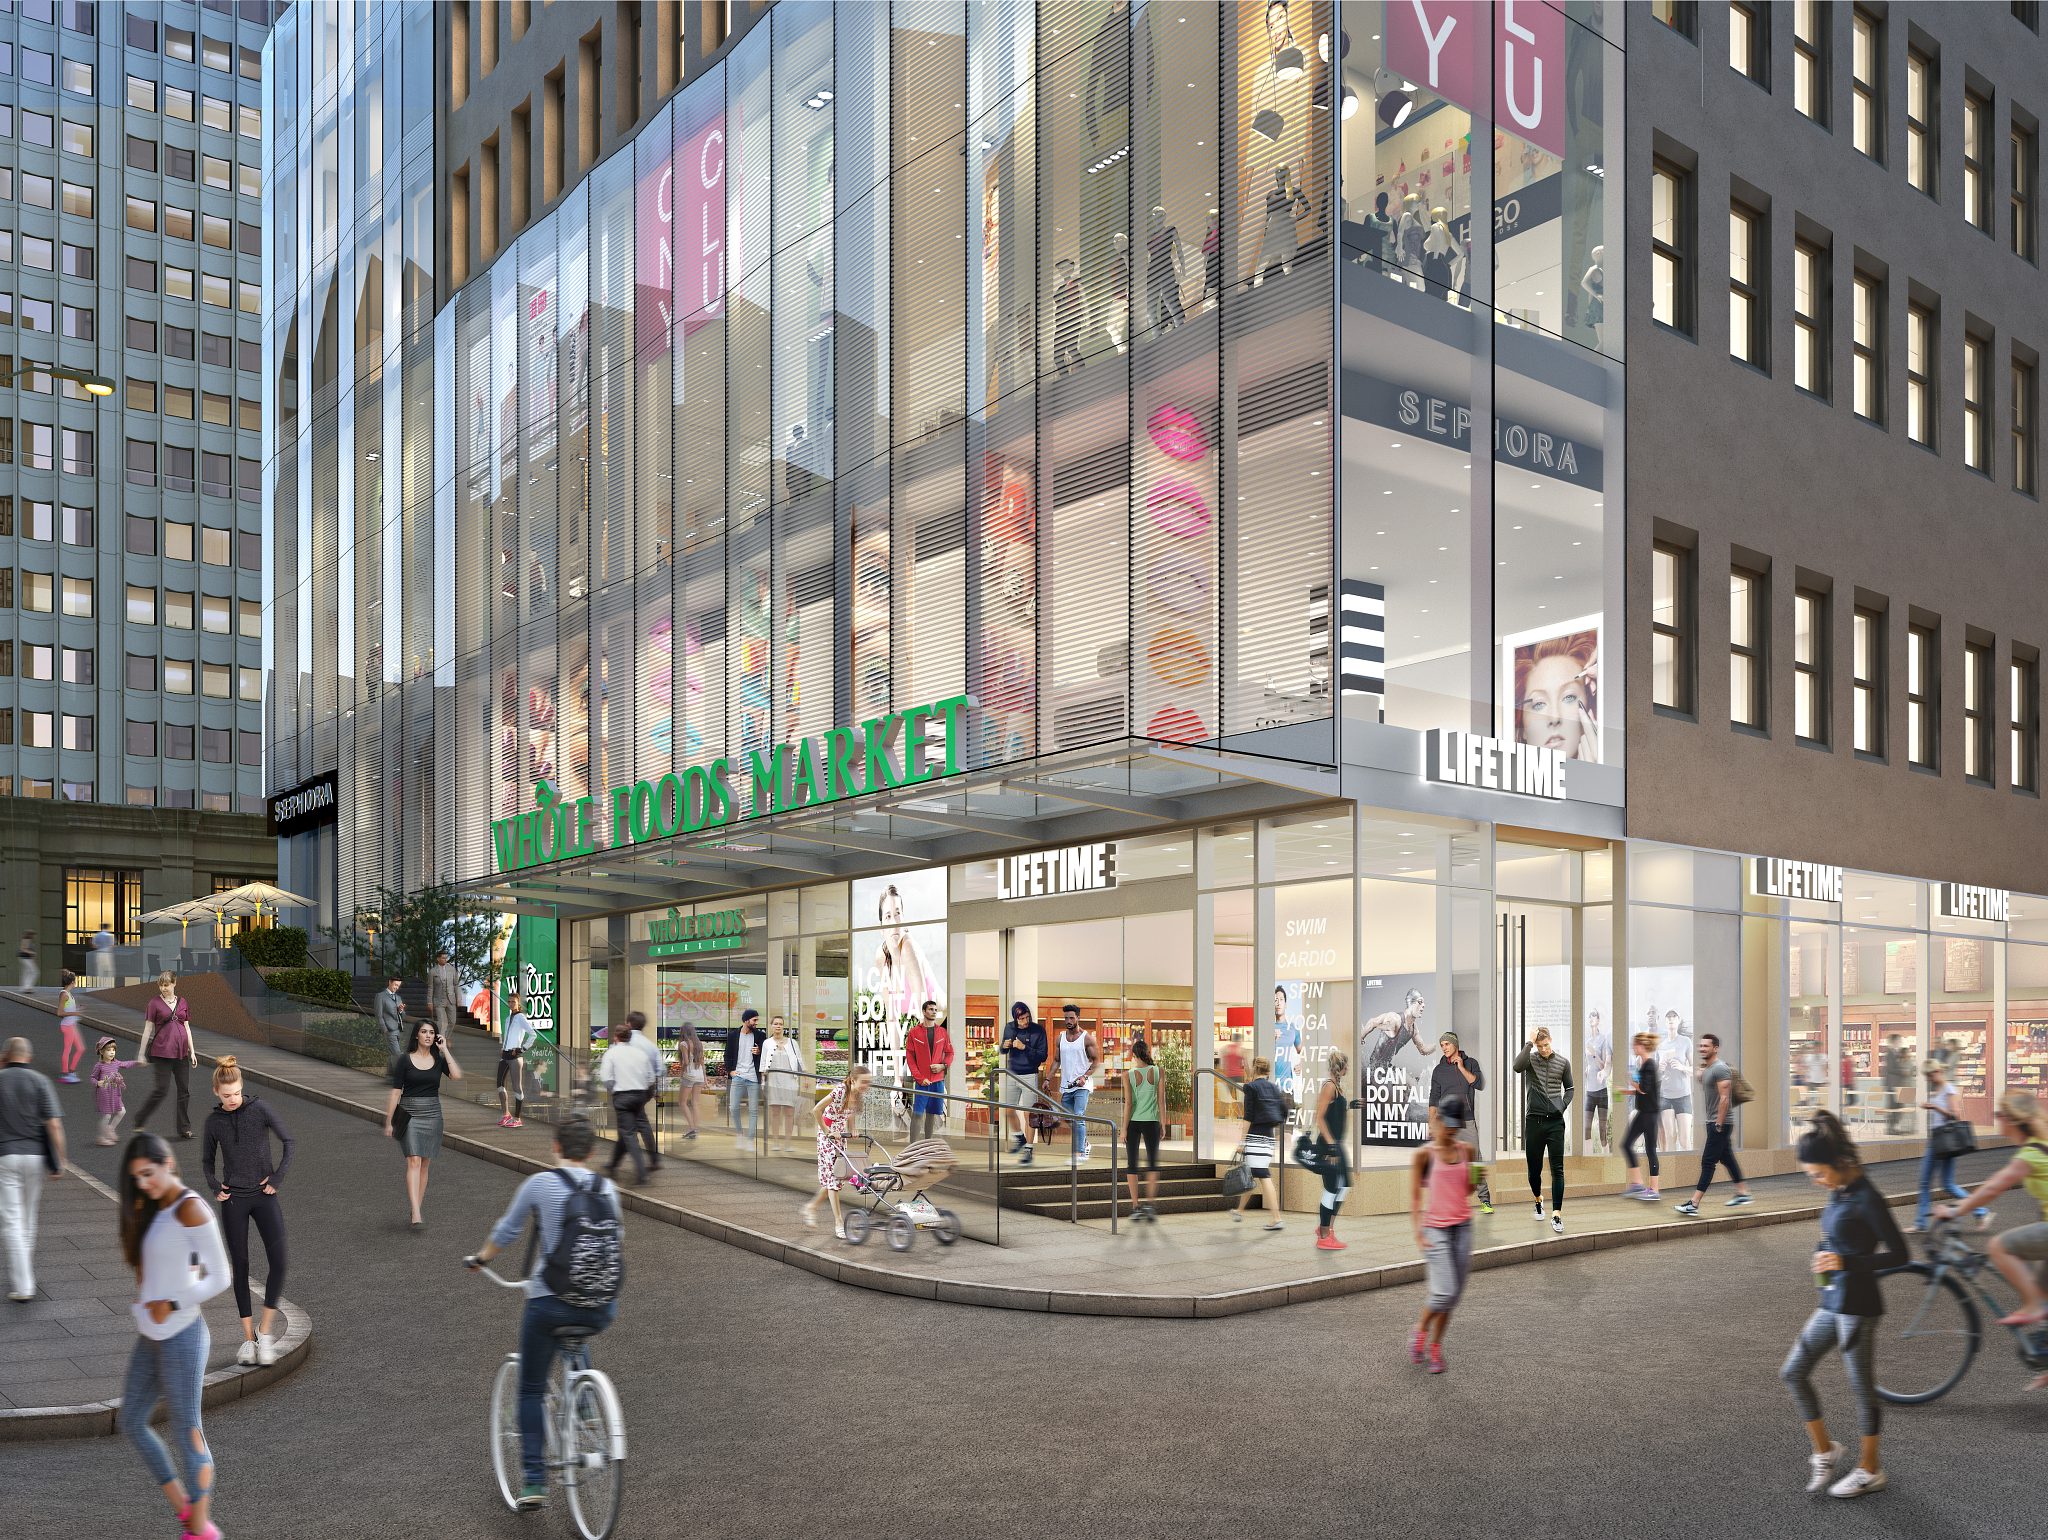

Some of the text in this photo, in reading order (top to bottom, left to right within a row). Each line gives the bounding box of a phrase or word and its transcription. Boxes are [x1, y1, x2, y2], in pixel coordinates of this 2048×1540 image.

[1399, 390, 1579, 475] SEPORA
[1436, 728, 1567, 800] LIFETIME
[492, 695, 975, 872] WHOLE FOODS MARKET
[275, 782, 333, 822] SEPHORA
[998, 843, 1113, 900] LIFETIME
[1766, 857, 1843, 902] LIFETIME
[1949, 882, 2010, 922] LIFETIME
[648, 907, 744, 944] WHOLE FOODS
[1286, 917, 1327, 937] SWIM
[657, 939, 731, 954] MARKET
[1277, 948, 1336, 969] CARDIO
[866, 966, 905, 993] CAN
[1289, 981, 1324, 1000] SPIN
[858, 994, 885, 1021] DO
[858, 1021, 910, 1050] IN MY
[1286, 1013, 1328, 1031] YOGA
[1367, 1067, 1407, 1085] I CAN
[1366, 1085, 1390, 1103] DO
[1392, 1085, 1408, 1103] IT
[1366, 1103, 1409, 1121] IN MY
[1366, 1121, 1430, 1140] LIFETIM
